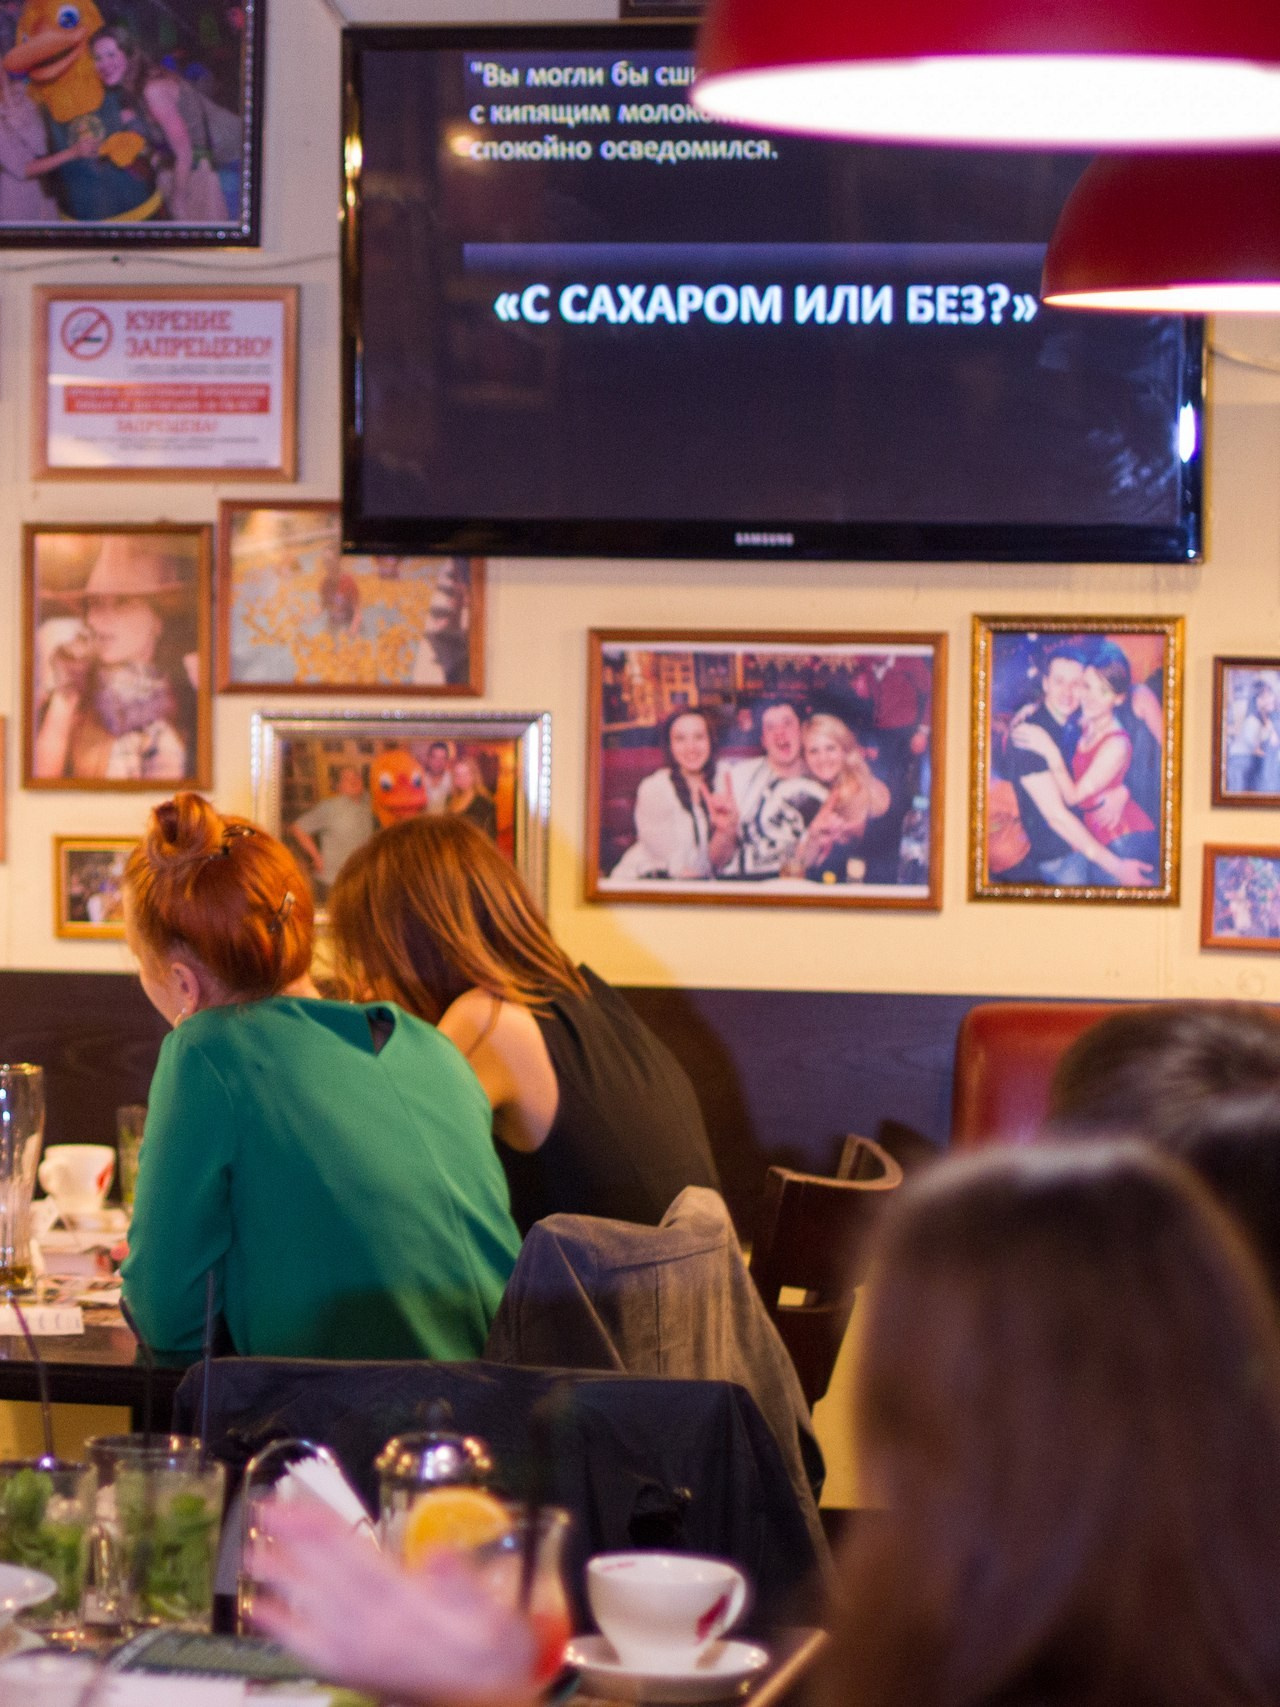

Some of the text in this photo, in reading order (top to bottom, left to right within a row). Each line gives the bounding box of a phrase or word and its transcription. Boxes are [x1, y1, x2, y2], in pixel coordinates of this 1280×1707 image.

[526, 66, 604, 87] могли
[611, 60, 649, 87] бы
[470, 104, 485, 124] с
[490, 103, 611, 128] кипящим
[470, 134, 779, 165] спокойно осведомился.
[559, 283, 783, 325] САХАРОМ
[794, 284, 893, 325] ИЛИ
[907, 283, 1038, 325] БЕЗ?»
[125, 310, 232, 331] КУРЕНИЕ
